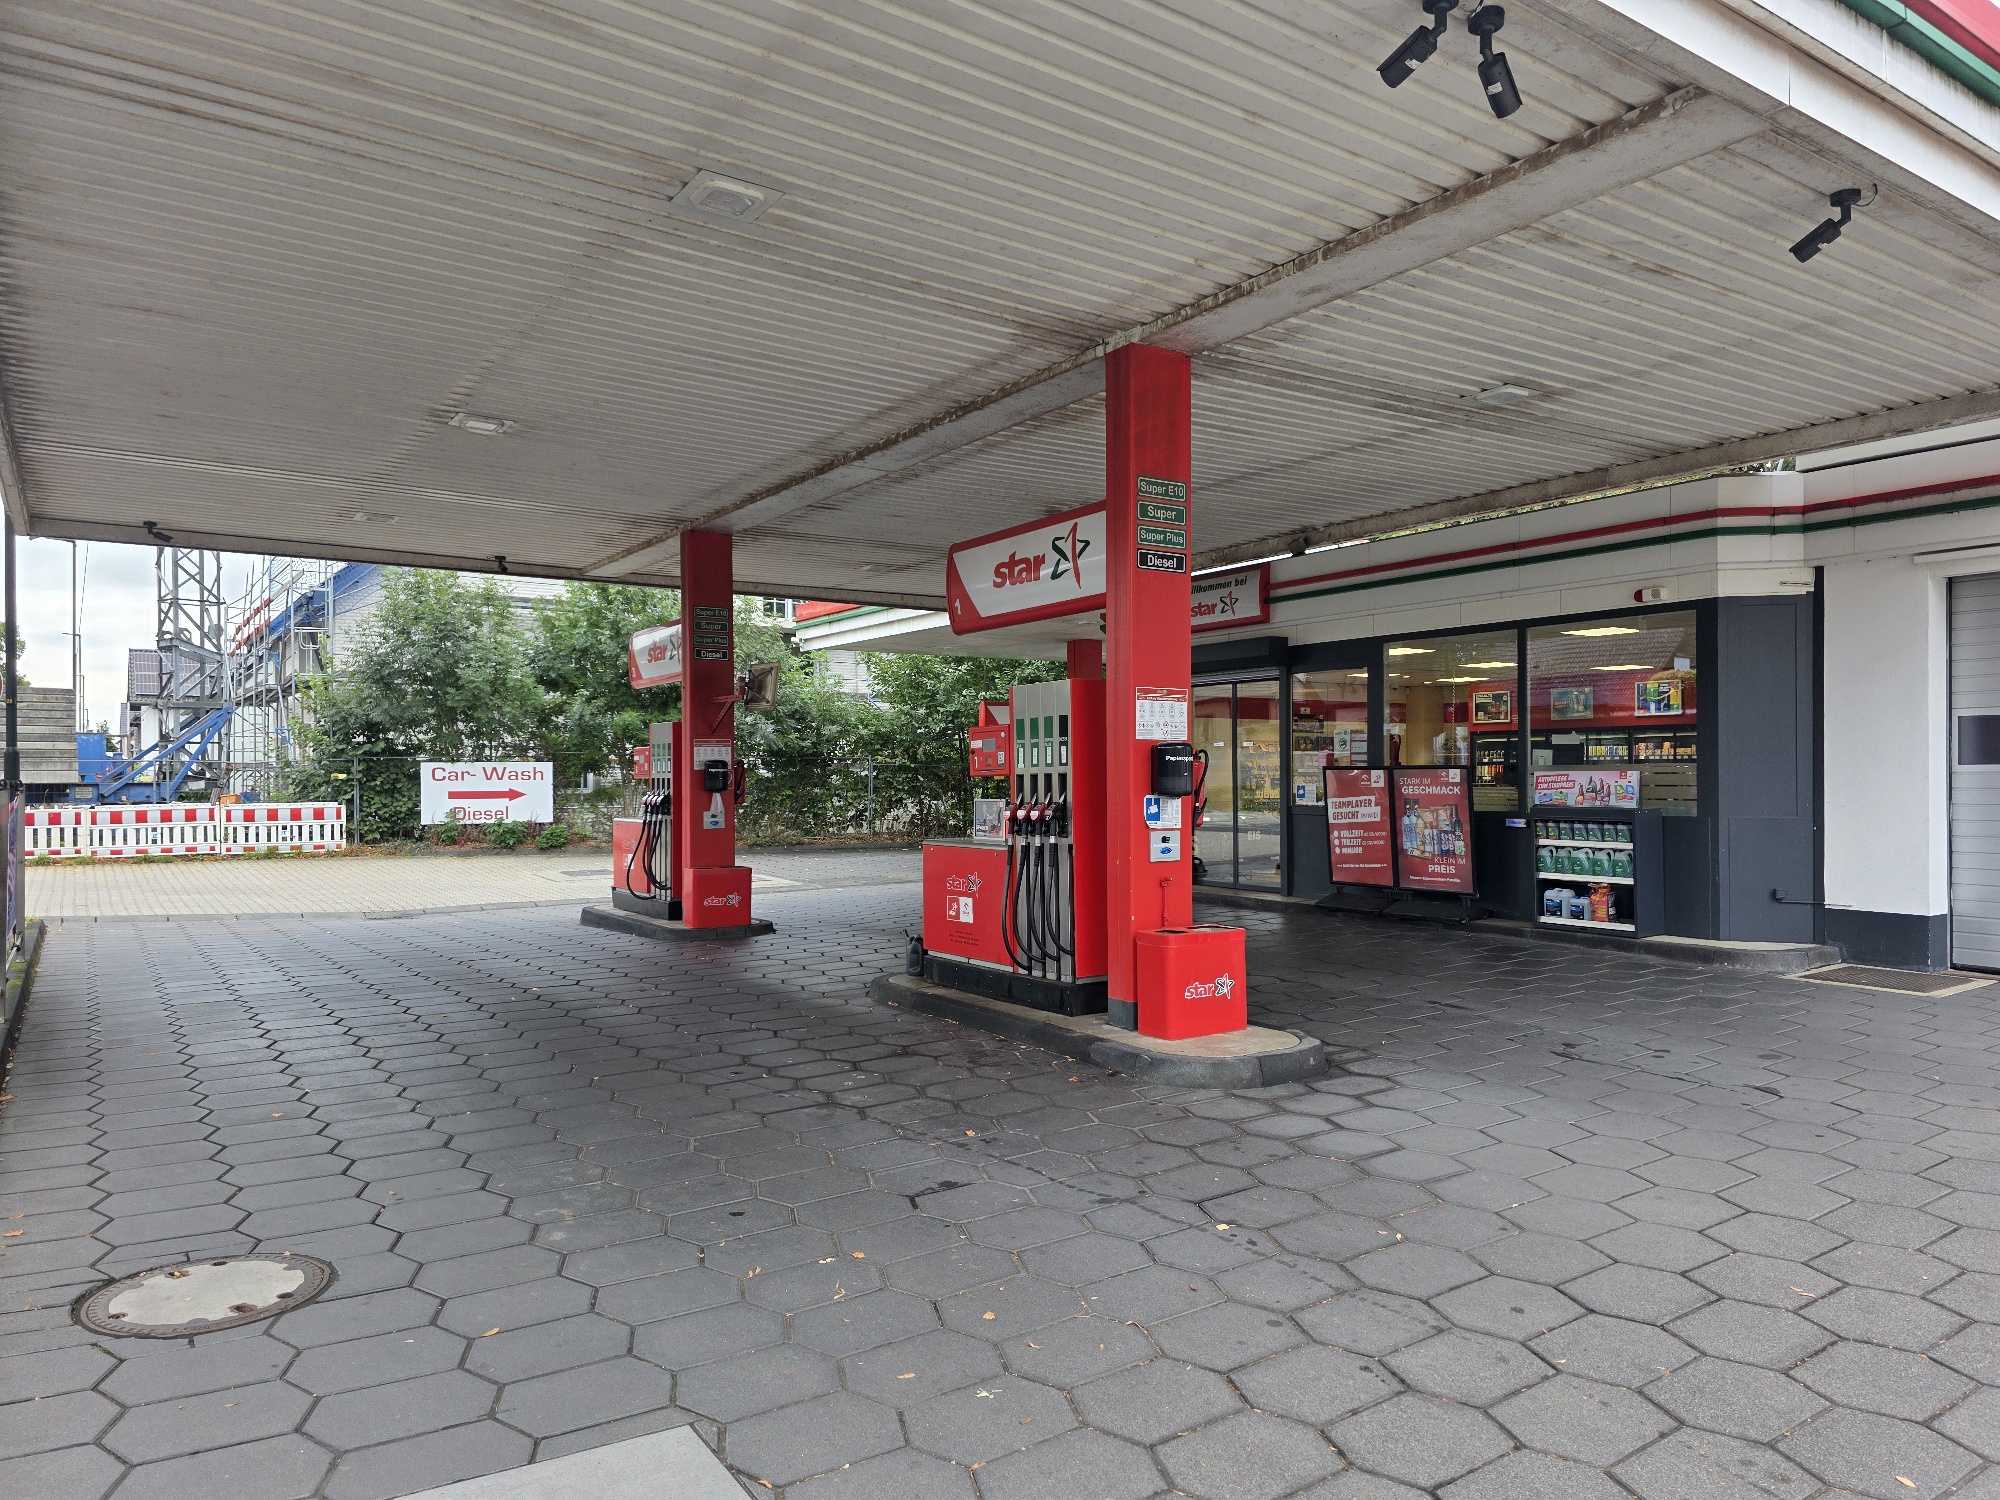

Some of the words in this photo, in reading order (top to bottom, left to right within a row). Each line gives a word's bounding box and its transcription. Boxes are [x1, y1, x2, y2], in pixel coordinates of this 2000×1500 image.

[1140, 481, 1166, 494] Super
[1168, 485, 1184, 497] E10
[1147, 505, 1176, 520] Super
[1140, 529, 1164, 542] Super
[1166, 532, 1184, 544] Plus
[1147, 554, 1177, 569] Diesel
[992, 550, 1046, 588] star
[1234, 575, 1248, 587] bei
[695, 608, 714, 617] Super
[1191, 602, 1217, 617] star
[701, 622, 722, 631] Super
[647, 641, 668, 664] star
[701, 650, 723, 659] Diesel
[431, 766, 477, 782] Car-
[481, 766, 545, 781] Wash
[1399, 777, 1421, 785] STARK
[1422, 777, 1431, 785] IM
[1401, 785, 1461, 795] GESCHMACK
[1330, 798, 1373, 810] TEAMPLAYER
[453, 806, 509, 820] Diesel
[1332, 810, 1360, 821] GESUCHT
[1247, 831, 1261, 841] EIS
[1434, 856, 1456, 864] KLEIN
[1457, 857, 1467, 865] IM
[1428, 864, 1456, 874] PREIS
[703, 895, 727, 907] star
[1184, 982, 1215, 999] star
